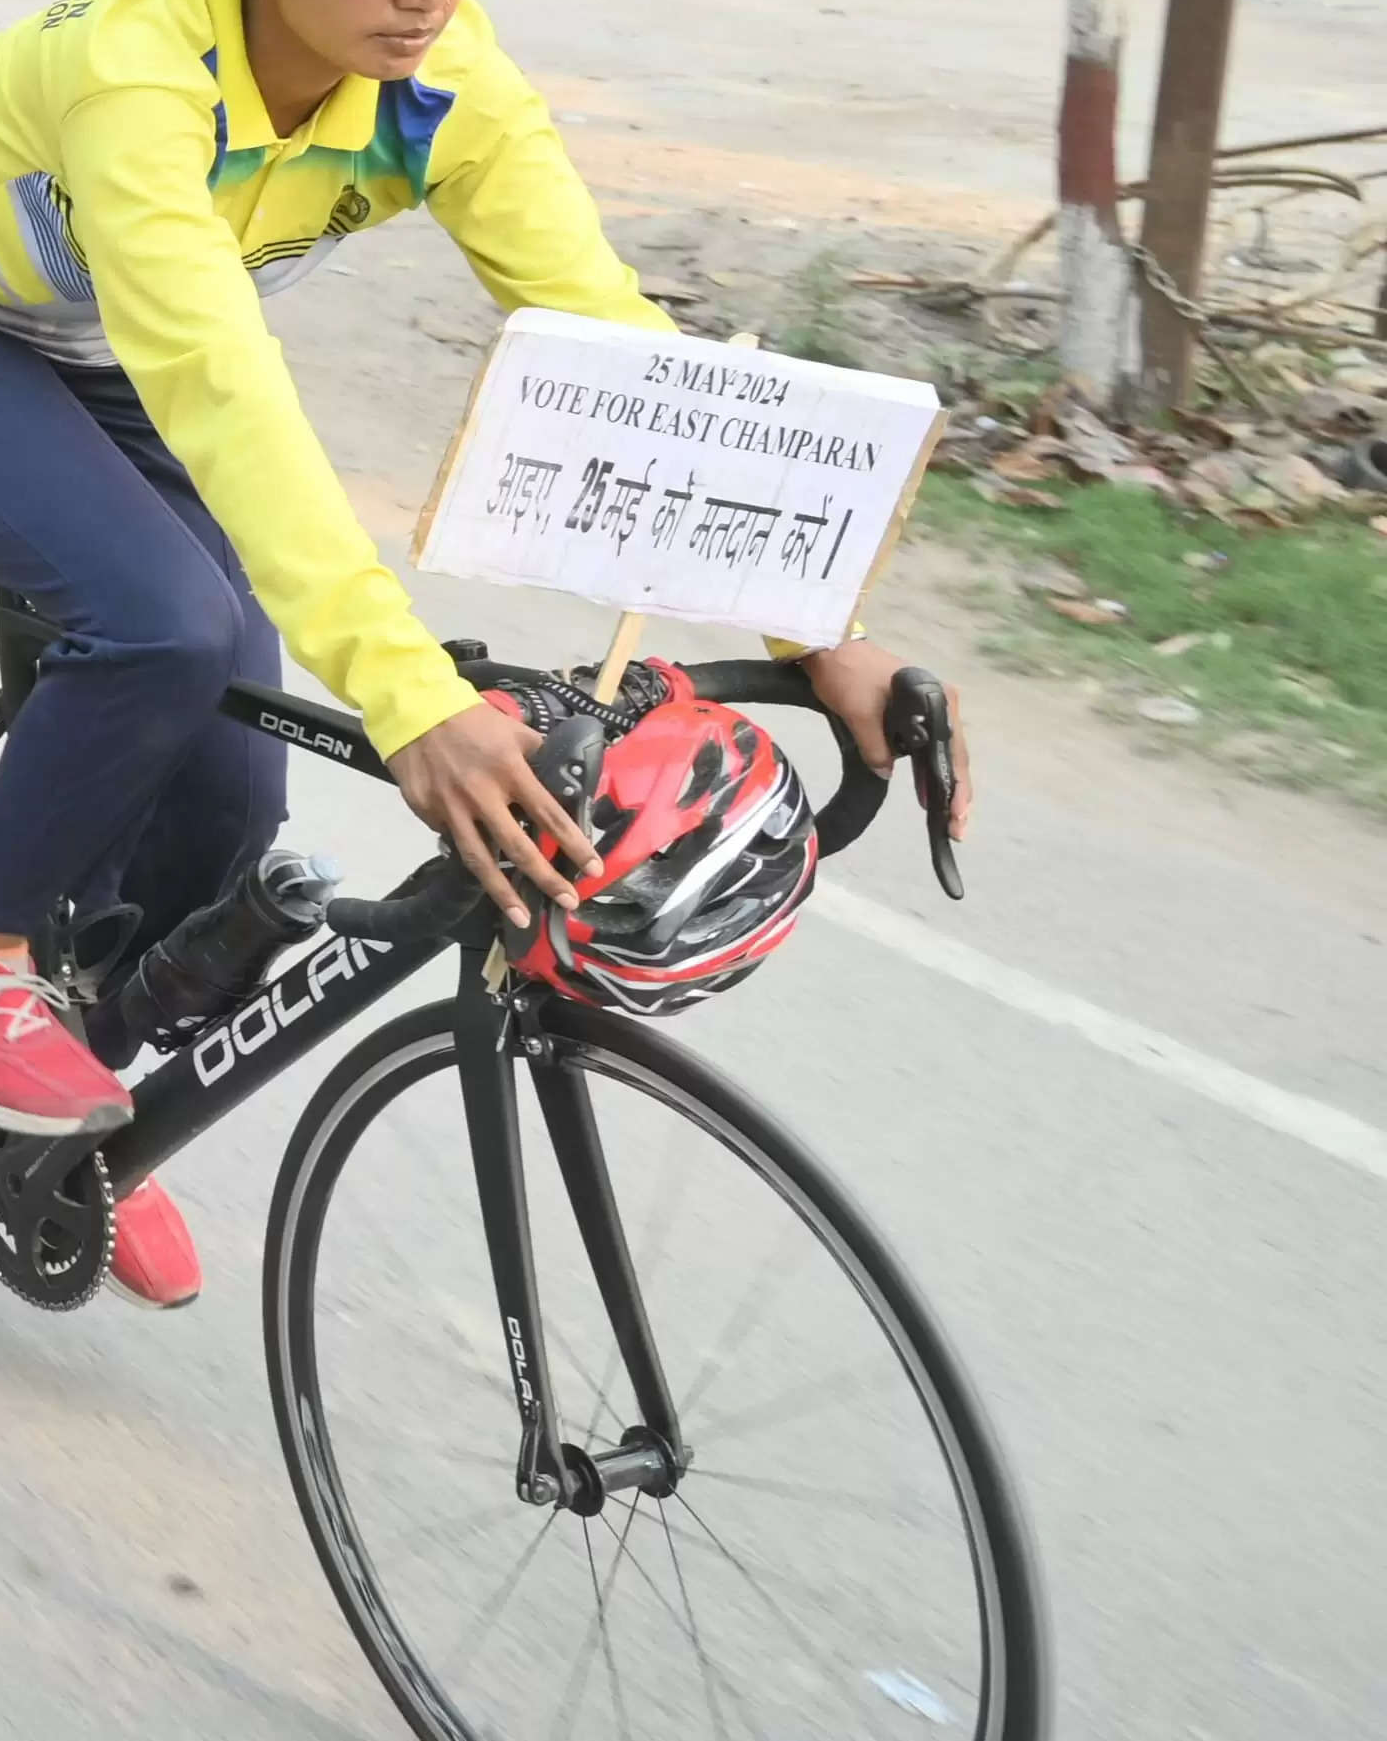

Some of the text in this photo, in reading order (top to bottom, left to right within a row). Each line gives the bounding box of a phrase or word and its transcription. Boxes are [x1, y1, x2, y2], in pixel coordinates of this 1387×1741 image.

[642, 353, 791, 408] 25 MAY 2024
[520, 375, 884, 473] VOTE FOR EAST CHAMPARAN
[651, 468, 694, 550] को
[689, 496, 782, 569] मतदान
[259, 711, 353, 760] DOLAN
